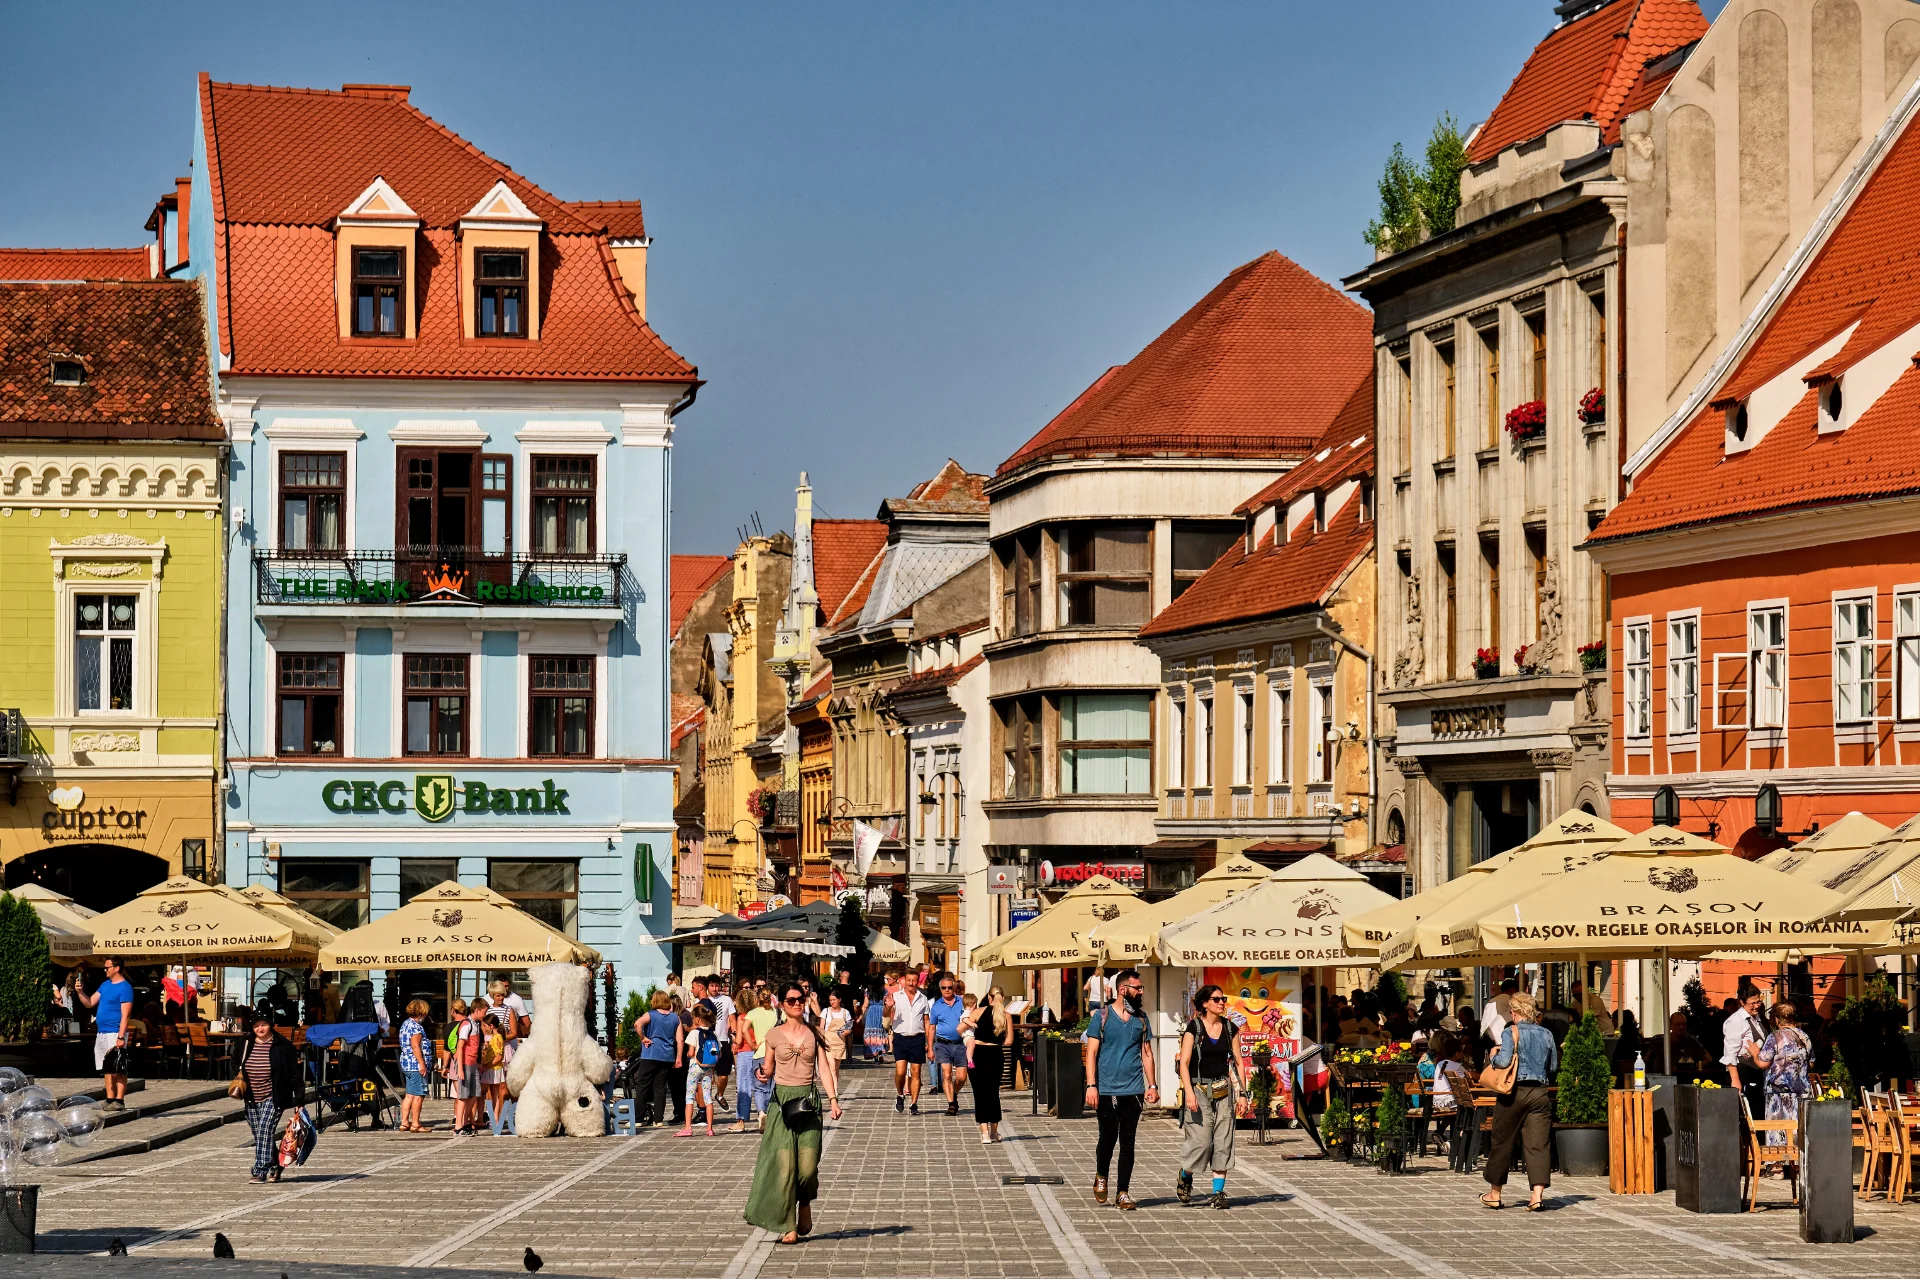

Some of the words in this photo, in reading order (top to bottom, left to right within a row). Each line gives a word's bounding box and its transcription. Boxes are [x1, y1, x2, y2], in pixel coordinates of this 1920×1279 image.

[276, 578, 328, 598] THE
[335, 578, 410, 599] BANK
[477, 580, 604, 600] Residence
[322, 779, 405, 812] CEC
[461, 778, 570, 812] Bank
[1054, 861, 1143, 882] vodafone
[1599, 901, 1764, 916] BRAȘOV
[118, 922, 220, 935] BRAȘOV
[1216, 924, 1342, 937] KRONS
[1506, 924, 1580, 941] BRAȘOV.
[1586, 923, 1649, 937] REGELE
[1655, 921, 1748, 938] ORAȘELOR
[1754, 918, 1773, 934] ÎN
[104, 939, 143, 948] REGELE
[146, 937, 203, 949] ORAȘELOR
[206, 936, 218, 946] ÎN
[222, 934, 278, 945] ROMÂNIA.
[400, 933, 493, 945] BRASSÓ
[335, 955, 381, 966] BRAȘOV.
[384, 954, 423, 964] REGELE
[426, 953, 482, 964] ORAȘELOR
[485, 951, 497, 962] ÎN
[501, 951, 556, 962] ROMÂNIA.
[1016, 951, 1056, 960] BRAȘOV.
[1060, 949, 1080, 958] REG
[1182, 949, 1238, 962] BRAȘOV.
[1243, 949, 1291, 961] REGELE
